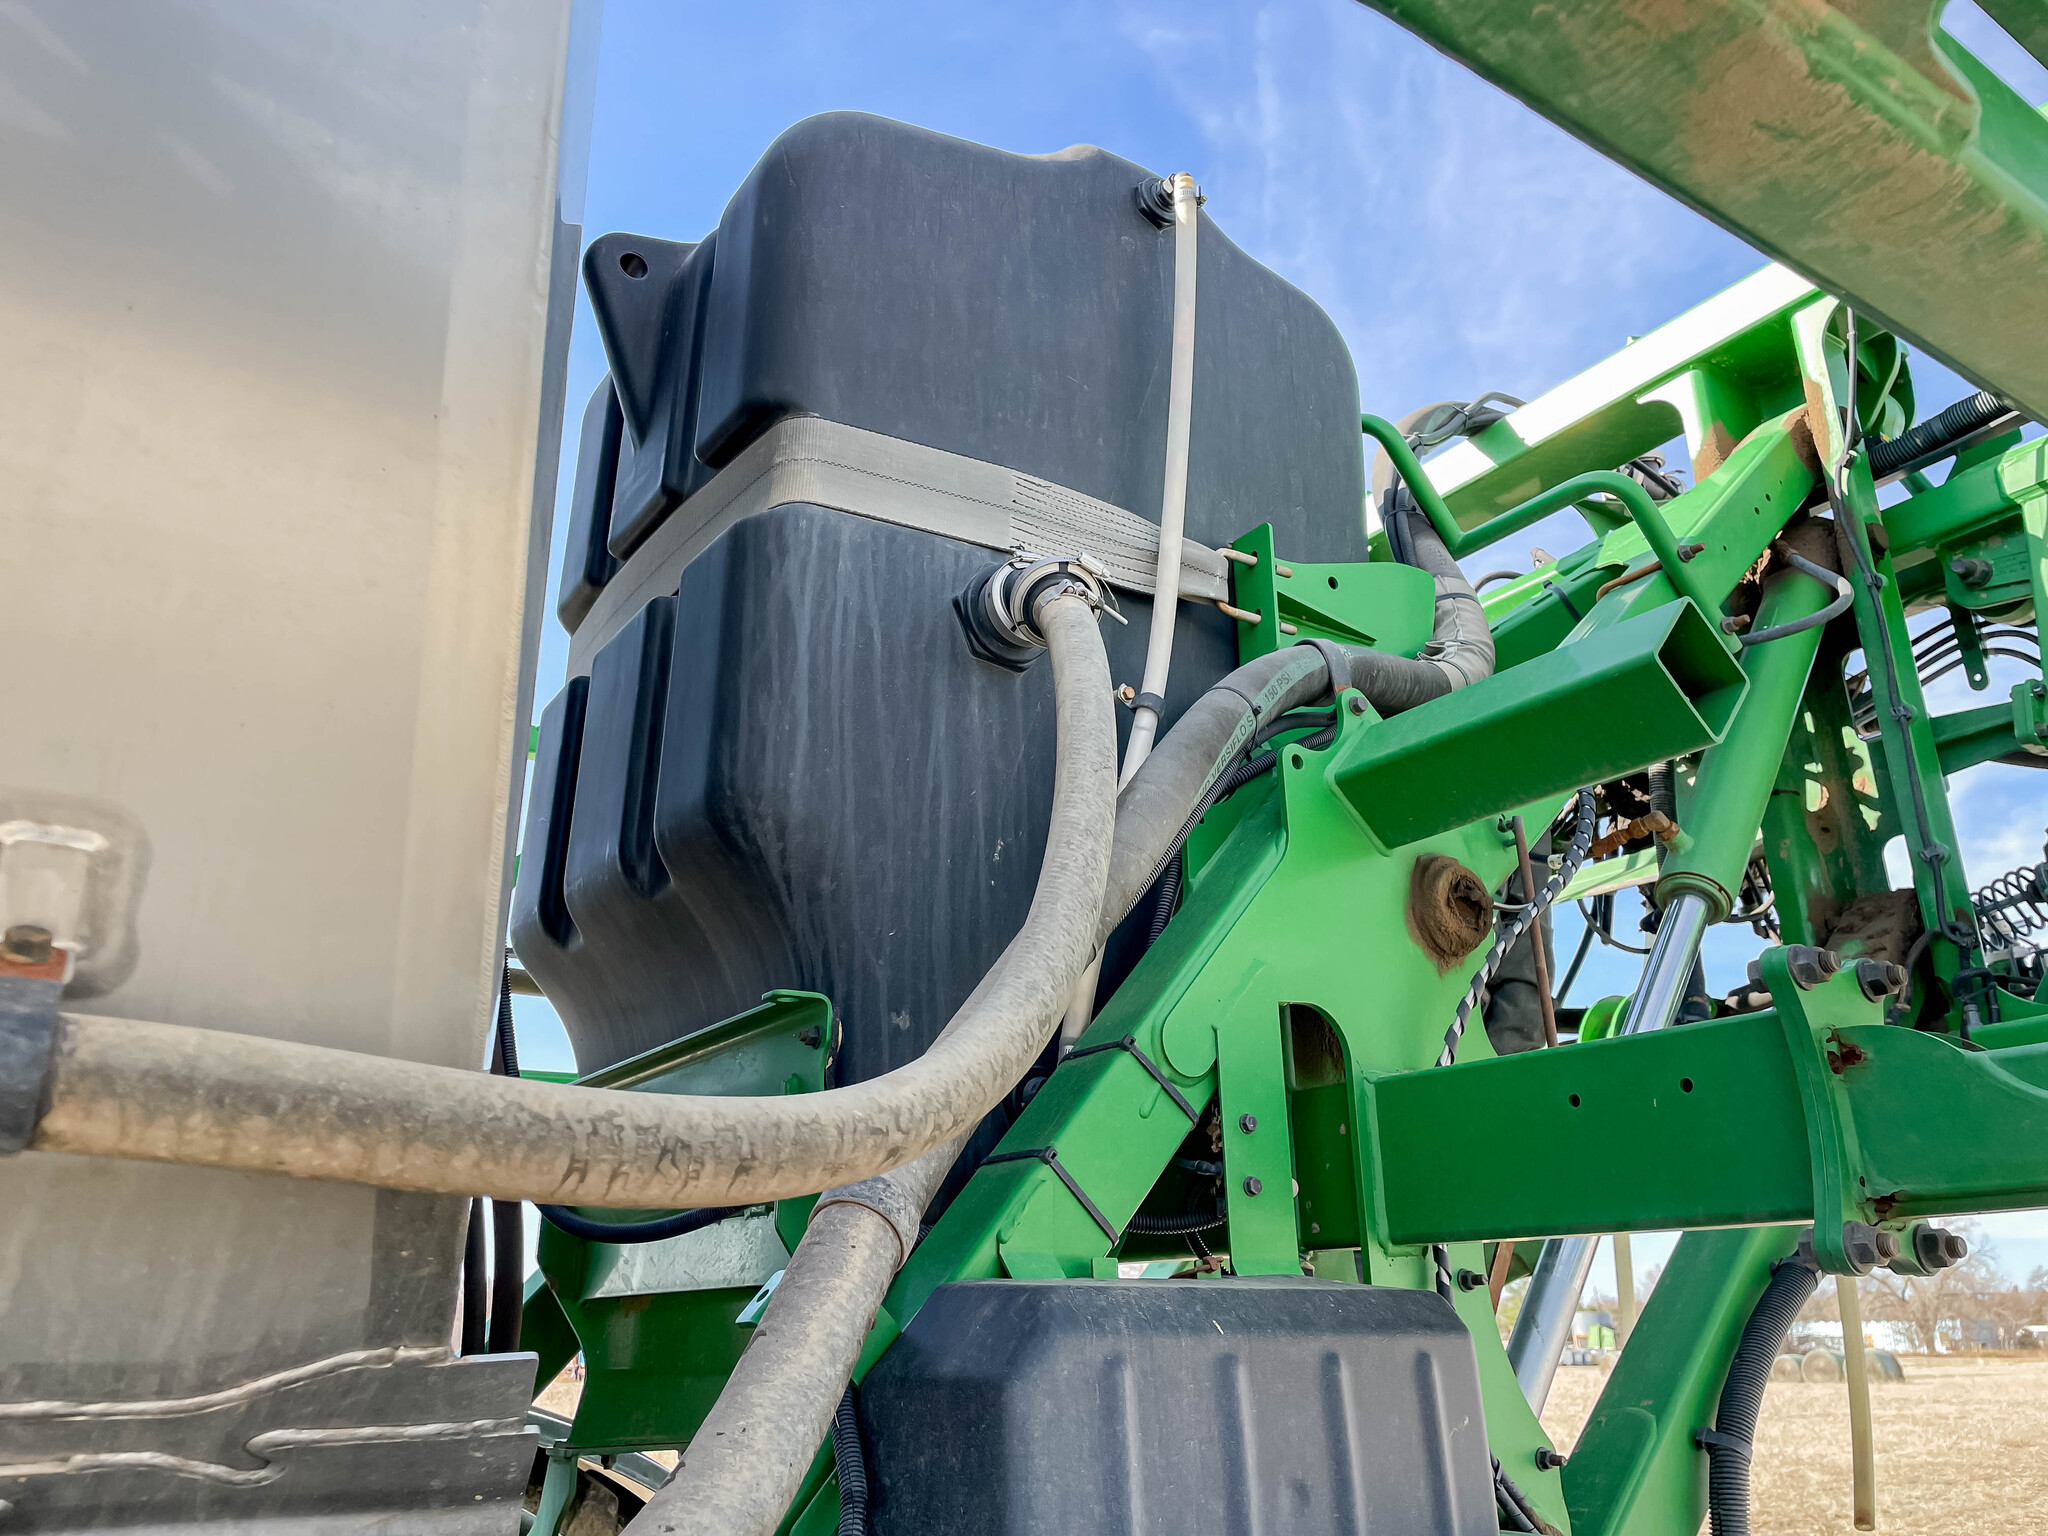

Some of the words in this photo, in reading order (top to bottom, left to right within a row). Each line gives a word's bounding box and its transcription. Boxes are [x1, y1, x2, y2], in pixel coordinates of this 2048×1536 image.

[1211, 726, 1247, 779] VERSIFLO
[1264, 683, 1279, 703] 150
[1277, 671, 1293, 691] PSI
